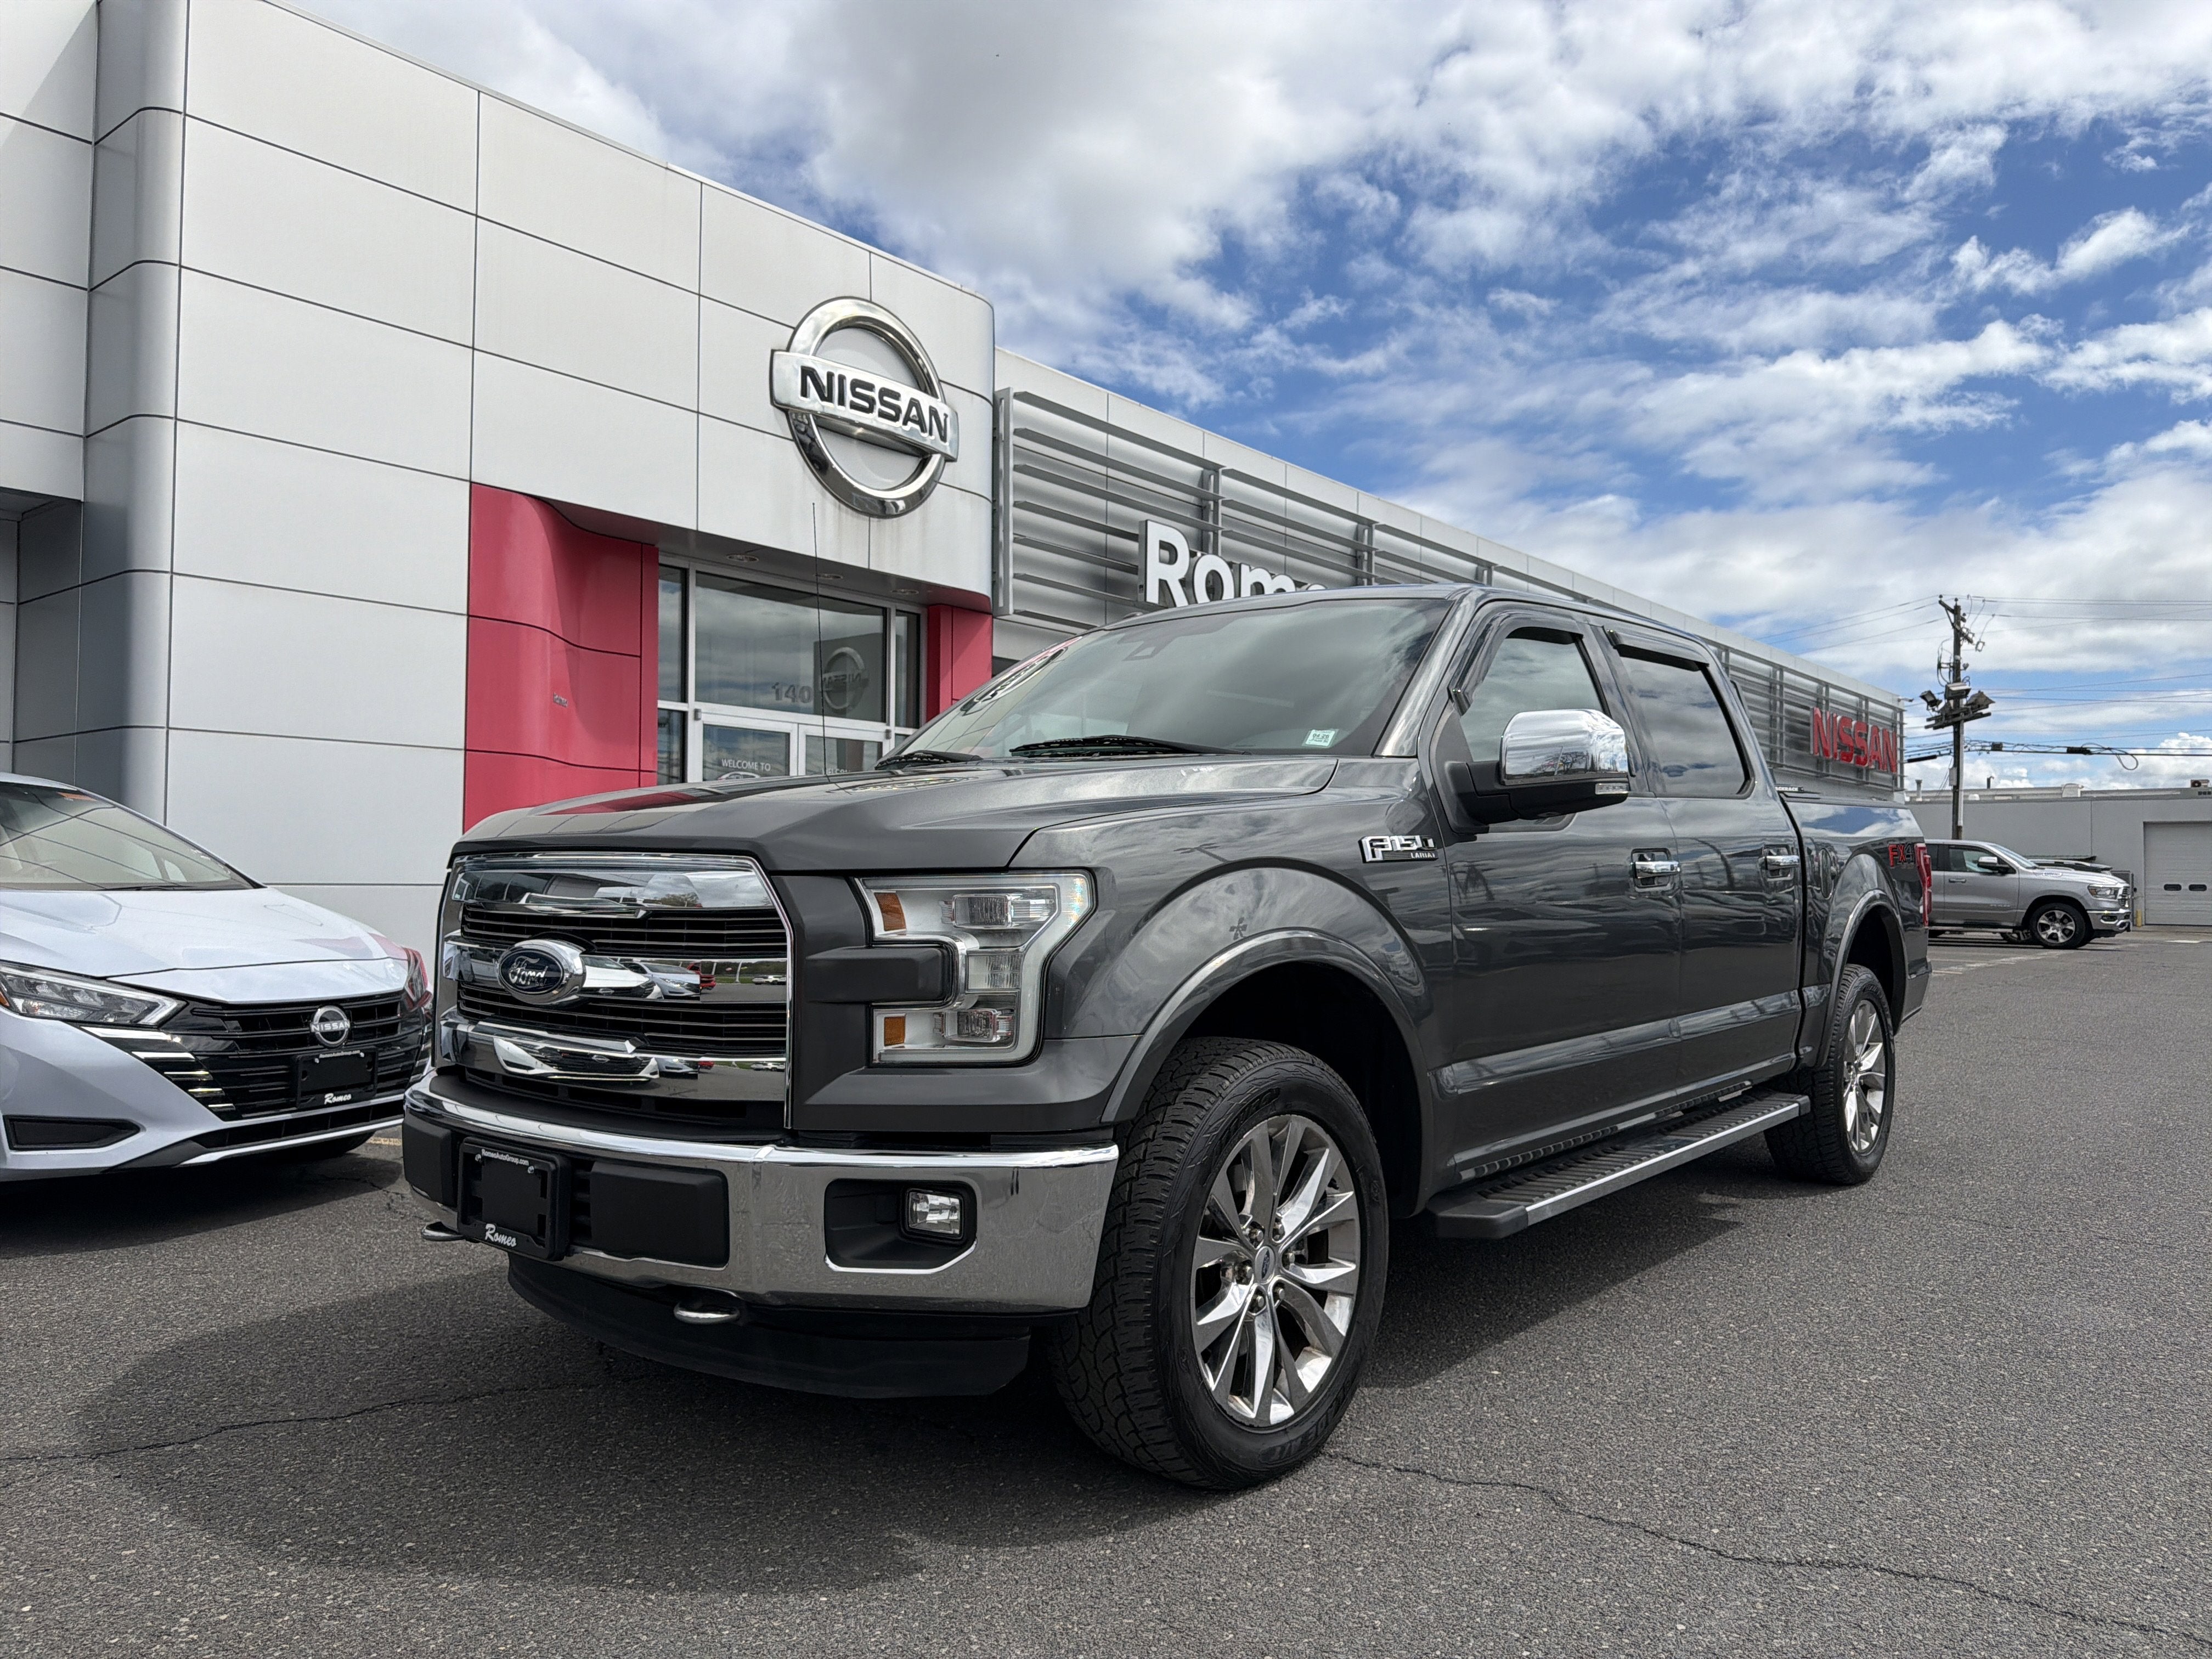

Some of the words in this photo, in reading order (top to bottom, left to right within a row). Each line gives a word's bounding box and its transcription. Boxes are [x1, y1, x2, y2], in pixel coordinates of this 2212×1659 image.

[799, 365, 948, 443] NISSAN
[1143, 519, 1328, 607] Rom
[771, 681, 812, 704] 140
[1812, 707, 1898, 773] NISSAN
[721, 758, 759, 770] WELCOME
[760, 762, 771, 771] TO
[1888, 843, 1914, 868] FX4
[509, 956, 549, 987] Ford
[311, 1021, 351, 1032] NISSAN
[324, 1093, 352, 1105] Romeo
[481, 1148, 529, 1166] RomeoAutoGroup.com
[485, 1223, 517, 1248] Romeo
